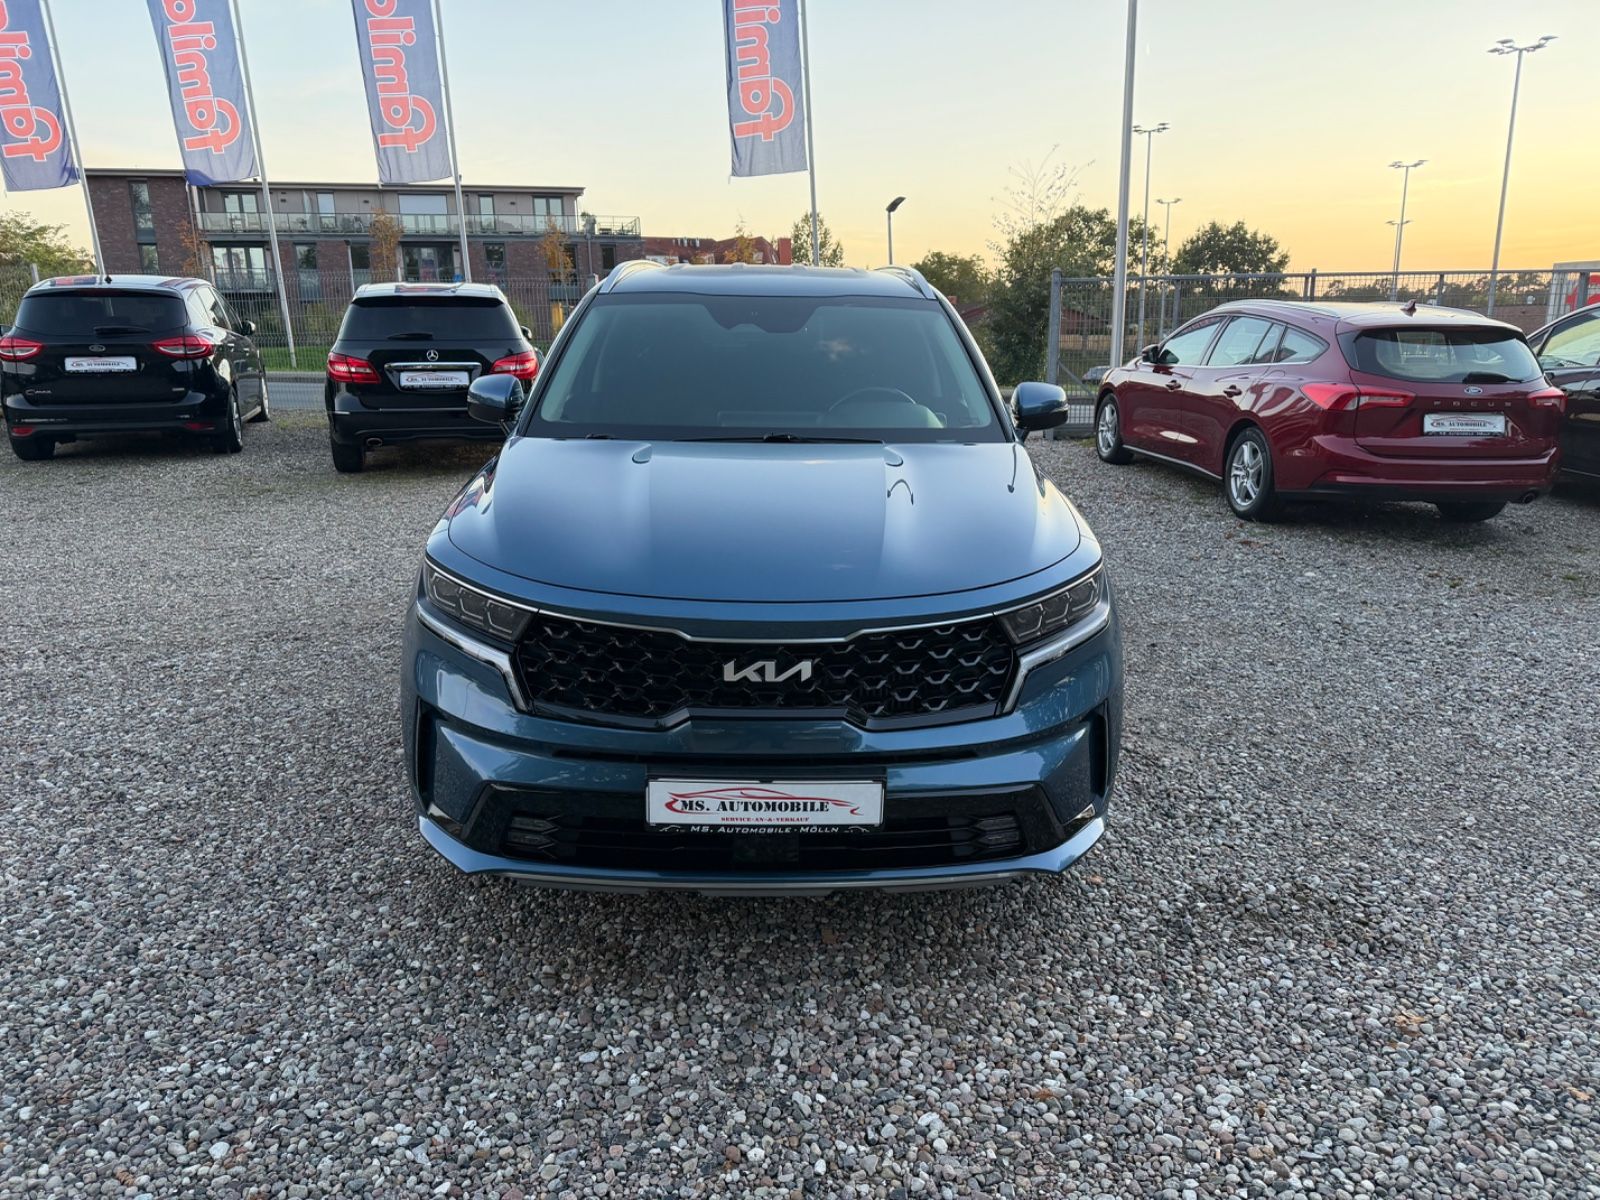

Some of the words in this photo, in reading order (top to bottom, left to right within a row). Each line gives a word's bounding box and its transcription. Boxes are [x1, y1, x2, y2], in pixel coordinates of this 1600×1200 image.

[681, 800, 710, 811] MS.
[717, 800, 829, 812] AUTOMOBILE
[690, 825, 713, 833] MS.
[717, 825, 792, 833] AUTOMOBILE
[799, 824, 839, 833] MÖLLN
